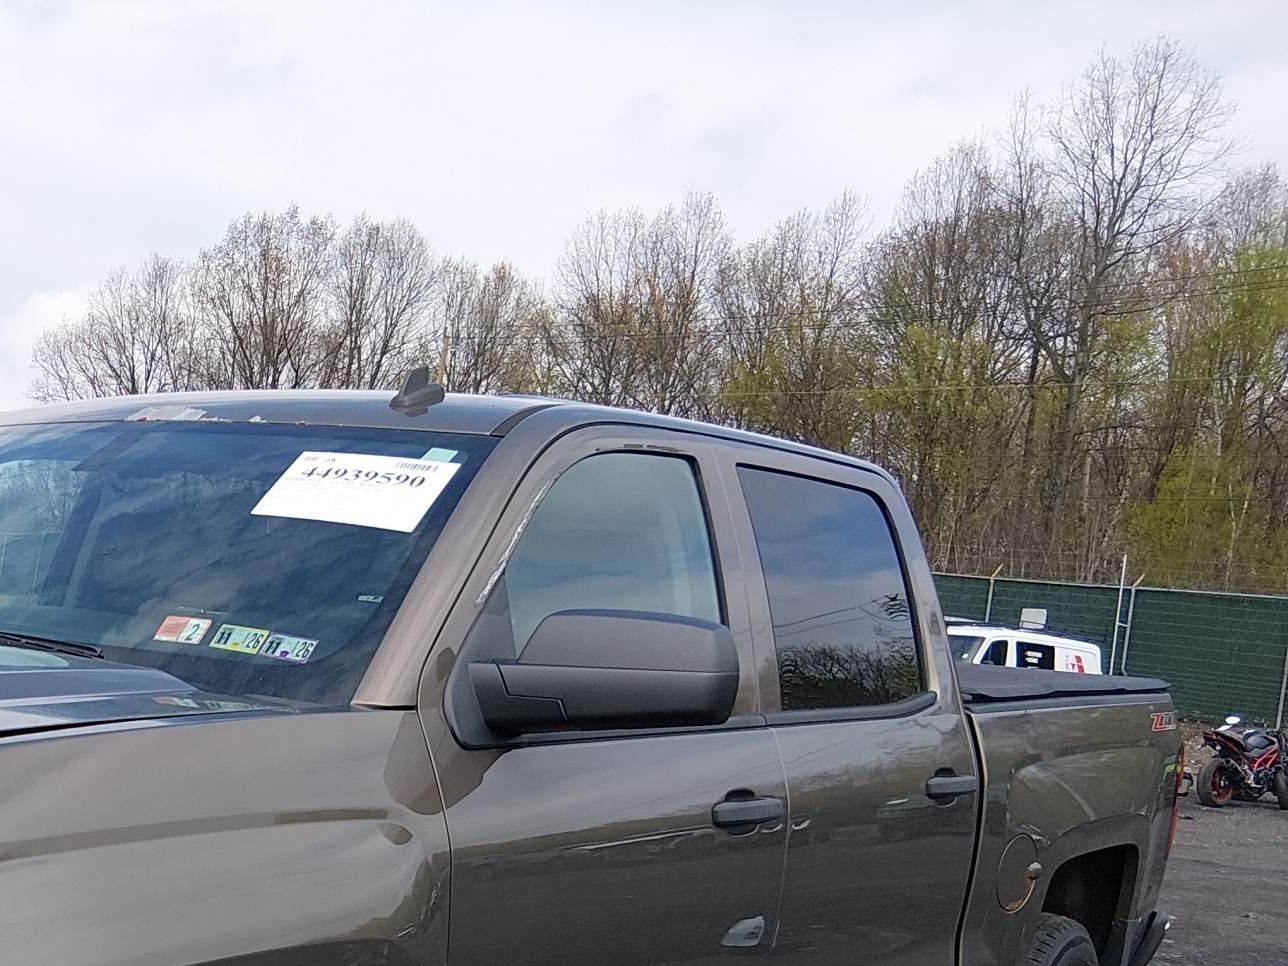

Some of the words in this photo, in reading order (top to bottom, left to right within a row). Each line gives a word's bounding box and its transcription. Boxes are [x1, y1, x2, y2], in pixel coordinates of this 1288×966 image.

[301, 466, 426, 488] 44939590
[185, 623, 200, 641] 2
[216, 631, 232, 645] 11
[246, 632, 264, 649] 26
[265, 639, 281, 654] 11
[296, 641, 314, 658] 26
